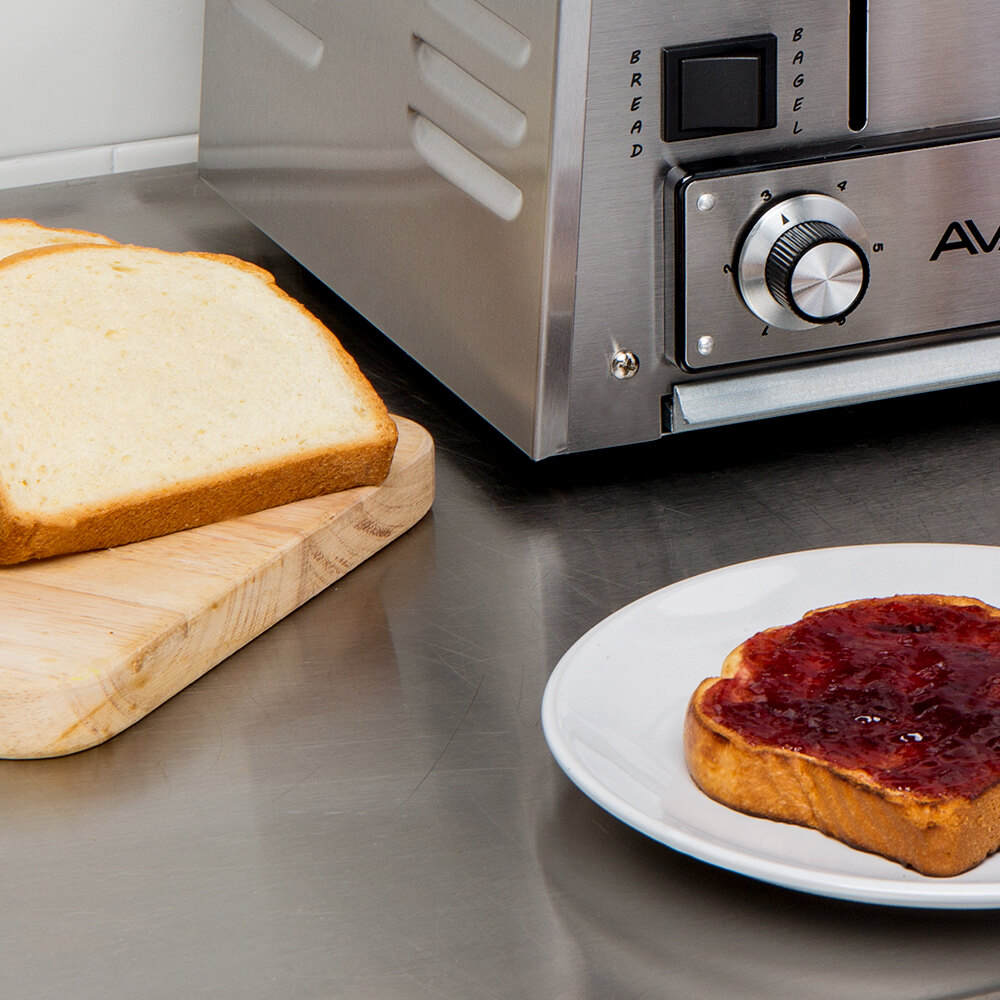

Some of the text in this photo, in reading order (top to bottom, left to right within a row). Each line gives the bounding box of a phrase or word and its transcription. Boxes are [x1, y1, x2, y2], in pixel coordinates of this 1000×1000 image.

[792, 27, 804, 135] BAGEL
[629, 49, 643, 158] BREAD
[837, 180, 848, 192] 4
[760, 189, 772, 201] 3
[873, 243, 883, 252] 5
